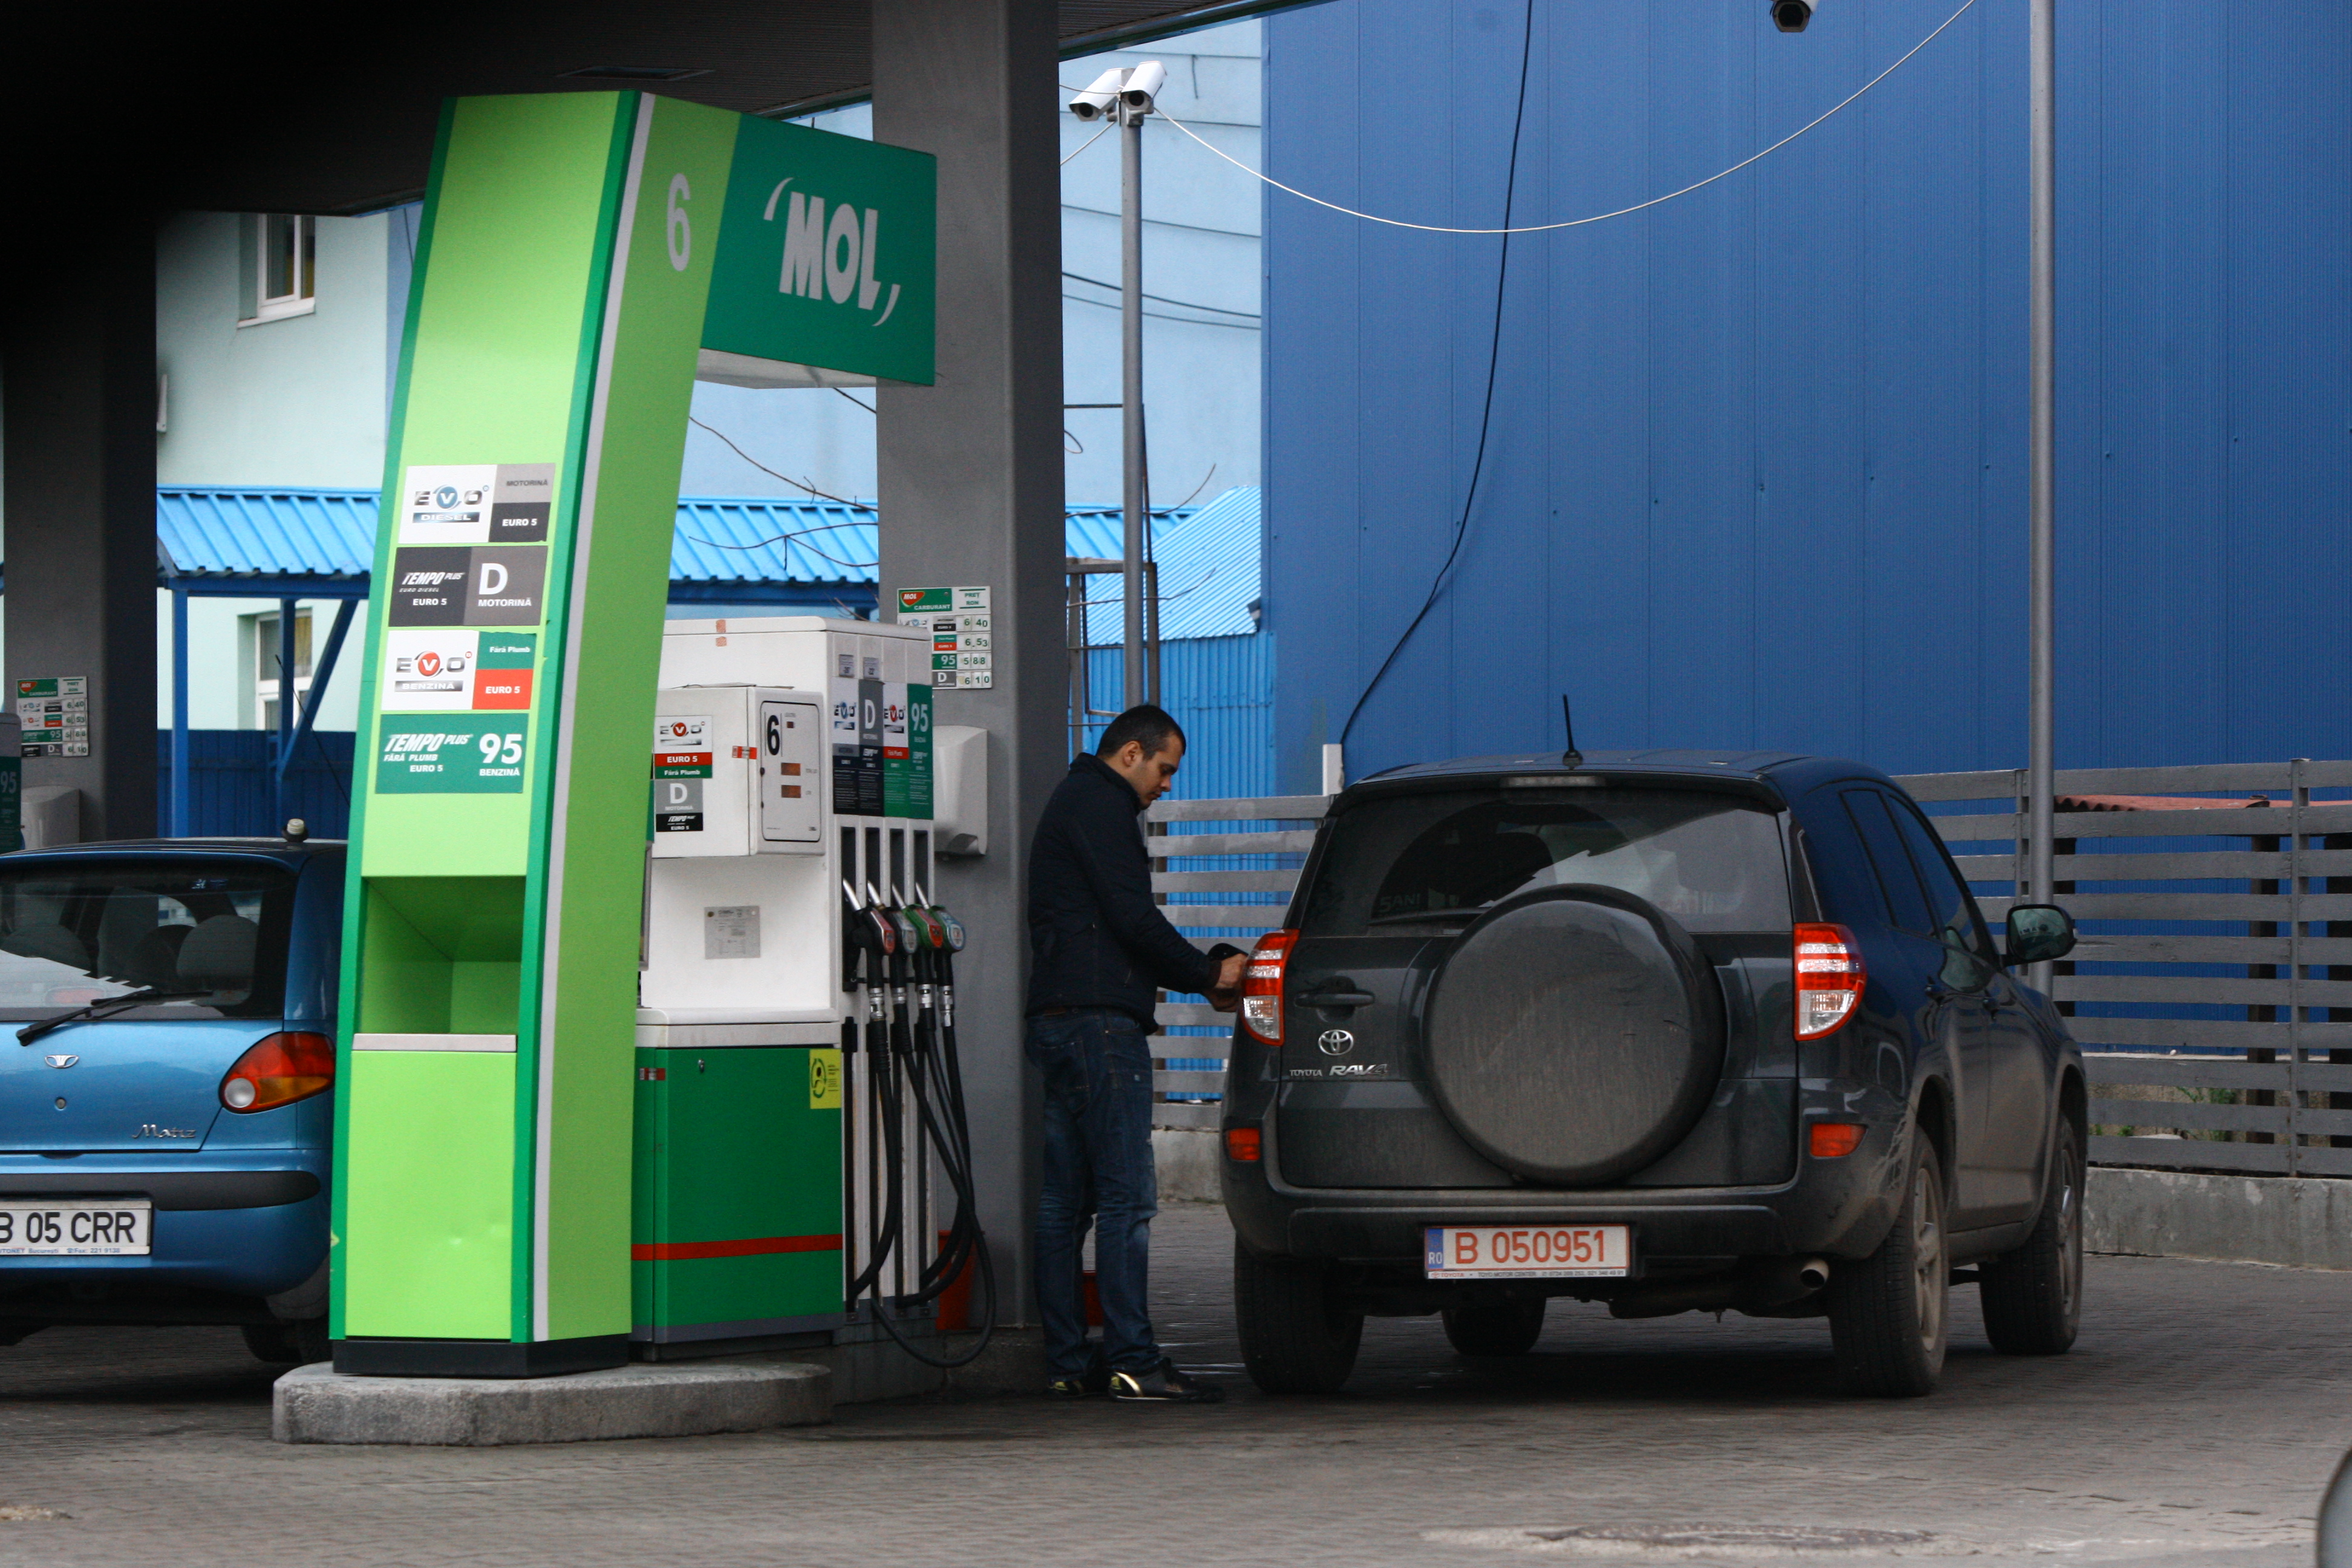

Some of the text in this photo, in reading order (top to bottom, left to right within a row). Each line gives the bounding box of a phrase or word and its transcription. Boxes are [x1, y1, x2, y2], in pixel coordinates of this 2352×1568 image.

[667, 173, 691, 272] 6
[779, 191, 881, 311] MOL
[414, 486, 483, 509] EVO
[402, 572, 445, 585] TEMPO
[479, 563, 508, 595] D
[396, 652, 465, 677] EVO
[941, 655, 956, 665] 95
[937, 672, 947, 683] D
[864, 699, 875, 730] D
[884, 704, 904, 723] EVO
[911, 702, 929, 733] 95
[660, 722, 702, 737] EVO
[767, 714, 780, 756] 6
[384, 733, 471, 752] TEMPO PLUS
[479, 733, 522, 764] 95
[1, 771, 17, 794] 95
[670, 783, 688, 804] D
[1329, 1063, 1388, 1076] RAV4
[132, 1123, 197, 1138] Matiz
[0, 1212, 136, 1243] B 05 CRR
[1428, 1252, 1443, 1264] RO
[1455, 1230, 1605, 1264] B 050951
